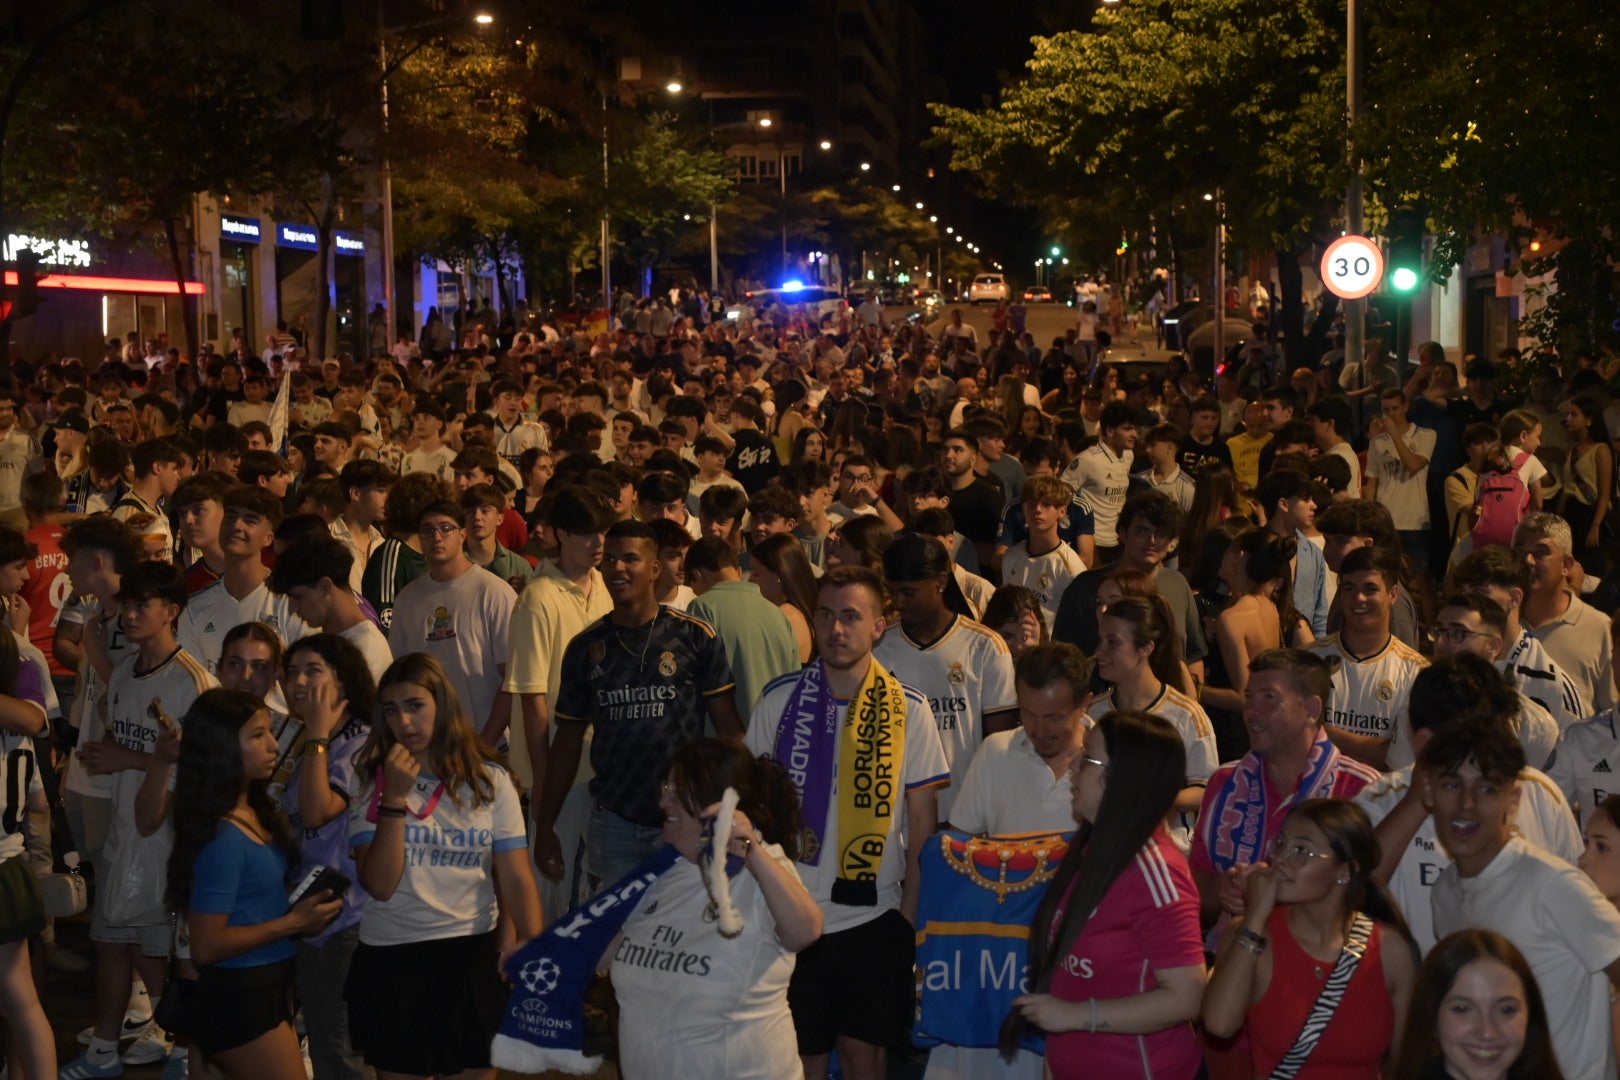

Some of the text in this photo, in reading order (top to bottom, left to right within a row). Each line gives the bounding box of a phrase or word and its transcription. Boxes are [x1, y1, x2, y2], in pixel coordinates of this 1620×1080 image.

[1335, 257, 1370, 277] 30
[597, 684, 677, 706] Emirates
[891, 688, 903, 715] POR
[609, 702, 665, 720] FLY BETTER
[826, 705, 836, 733] 2024
[1324, 706, 1390, 731] Emirates
[854, 687, 877, 808] BORUSSIA
[874, 675, 892, 818] DORTMUND
[431, 849, 483, 867] BETTER
[652, 925, 684, 947] Fly
[614, 936, 712, 977] Emirates
[926, 950, 961, 991] al
